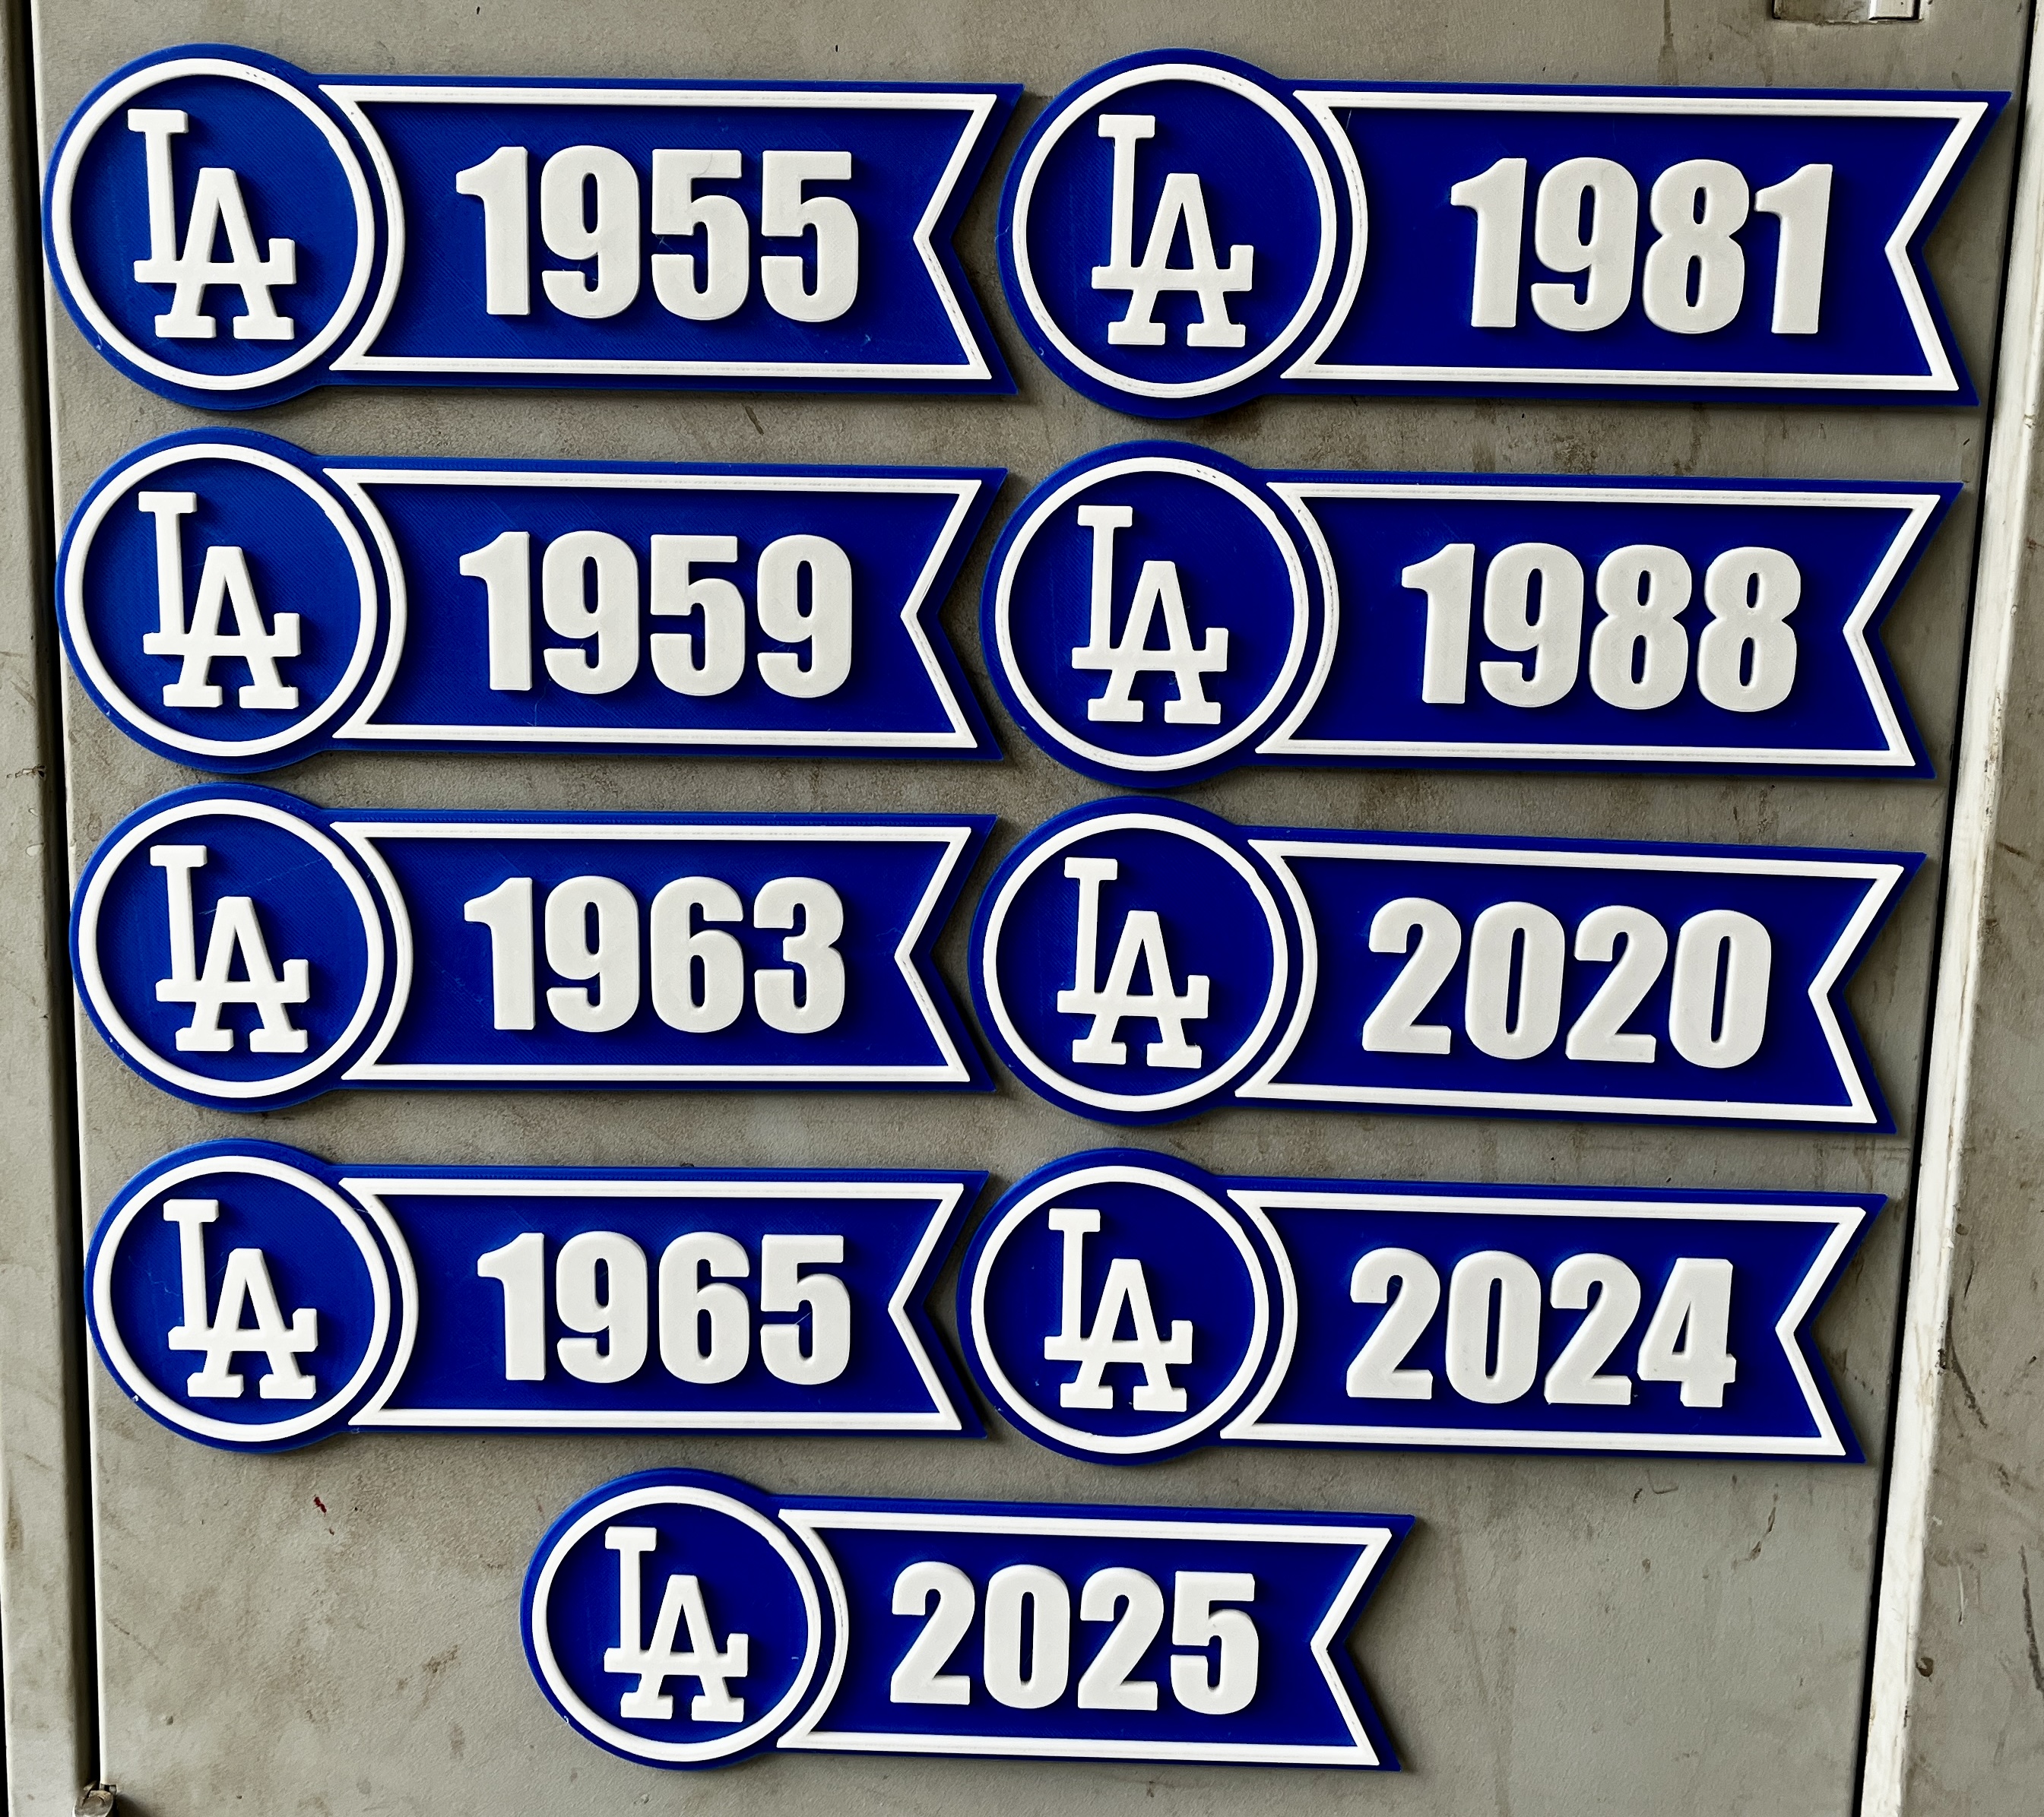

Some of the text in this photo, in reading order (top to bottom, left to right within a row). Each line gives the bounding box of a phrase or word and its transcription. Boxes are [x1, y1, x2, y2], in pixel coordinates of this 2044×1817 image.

[128, 109, 296, 342] LA
[456, 145, 860, 323] 1955
[1090, 113, 1254, 349] LA
[1451, 157, 1833, 334] 1981
[137, 491, 301, 711] LA
[460, 530, 853, 698] 1959
[1071, 505, 1229, 726] LA
[1402, 542, 1802, 713] 1988
[149, 844, 309, 1054] LA
[464, 875, 845, 1034] 1963
[1056, 856, 1210, 1069] LA
[1361, 897, 1772, 1068] 2020
[162, 1198, 318, 1401] LA
[477, 1230, 851, 1385] 1965
[1043, 1207, 1193, 1413] LA
[1345, 1247, 1737, 1409] 2024
[603, 1525, 749, 1724] LA
[889, 1561, 1260, 1715] 2025
